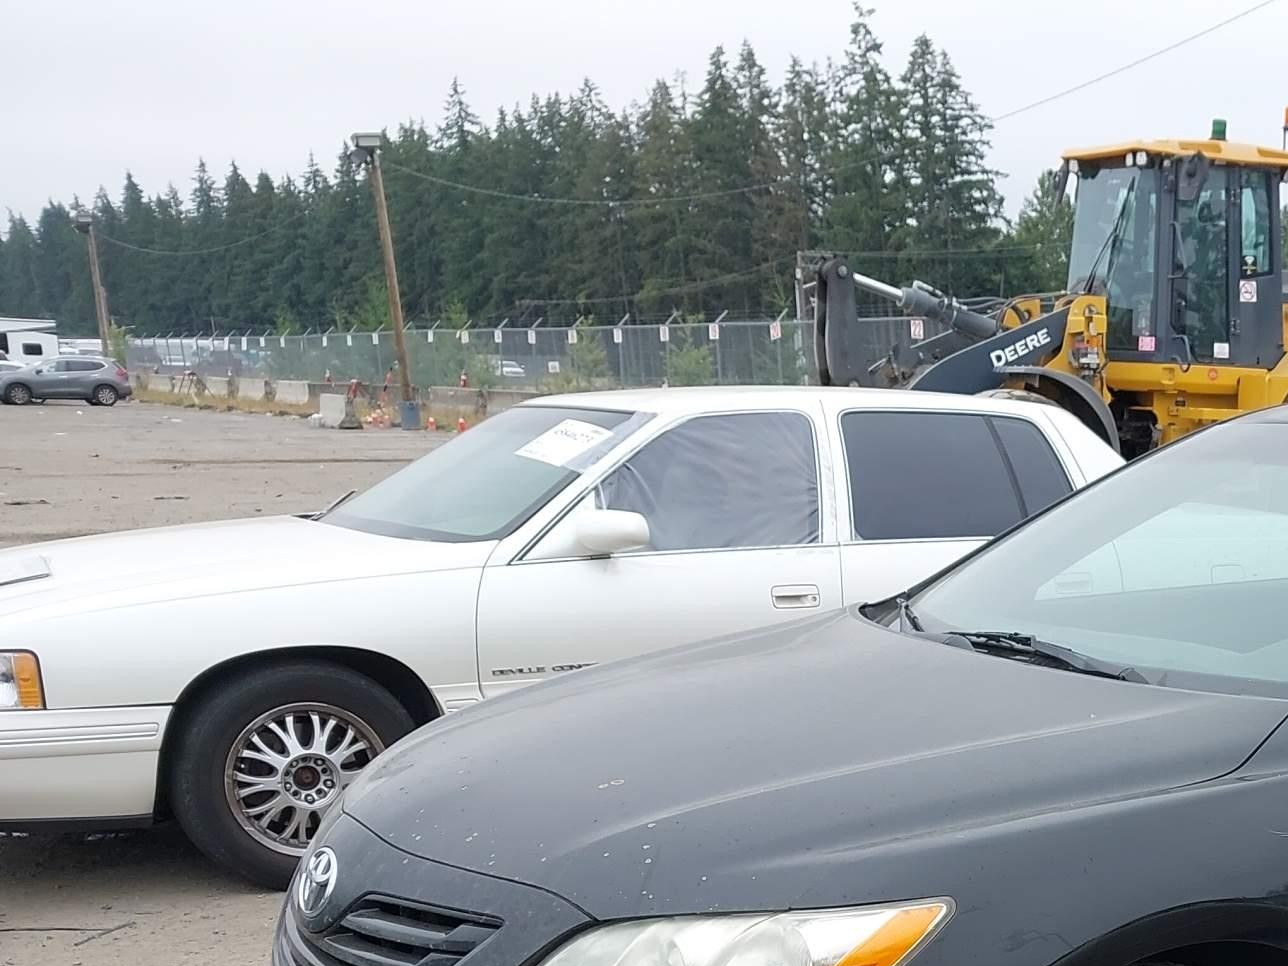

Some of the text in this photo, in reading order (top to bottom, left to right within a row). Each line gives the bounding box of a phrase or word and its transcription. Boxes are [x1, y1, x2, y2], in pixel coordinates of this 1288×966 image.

[911, 321, 922, 337] 22
[989, 327, 1051, 368] DEERE
[491, 666, 547, 676] DEVILLE
